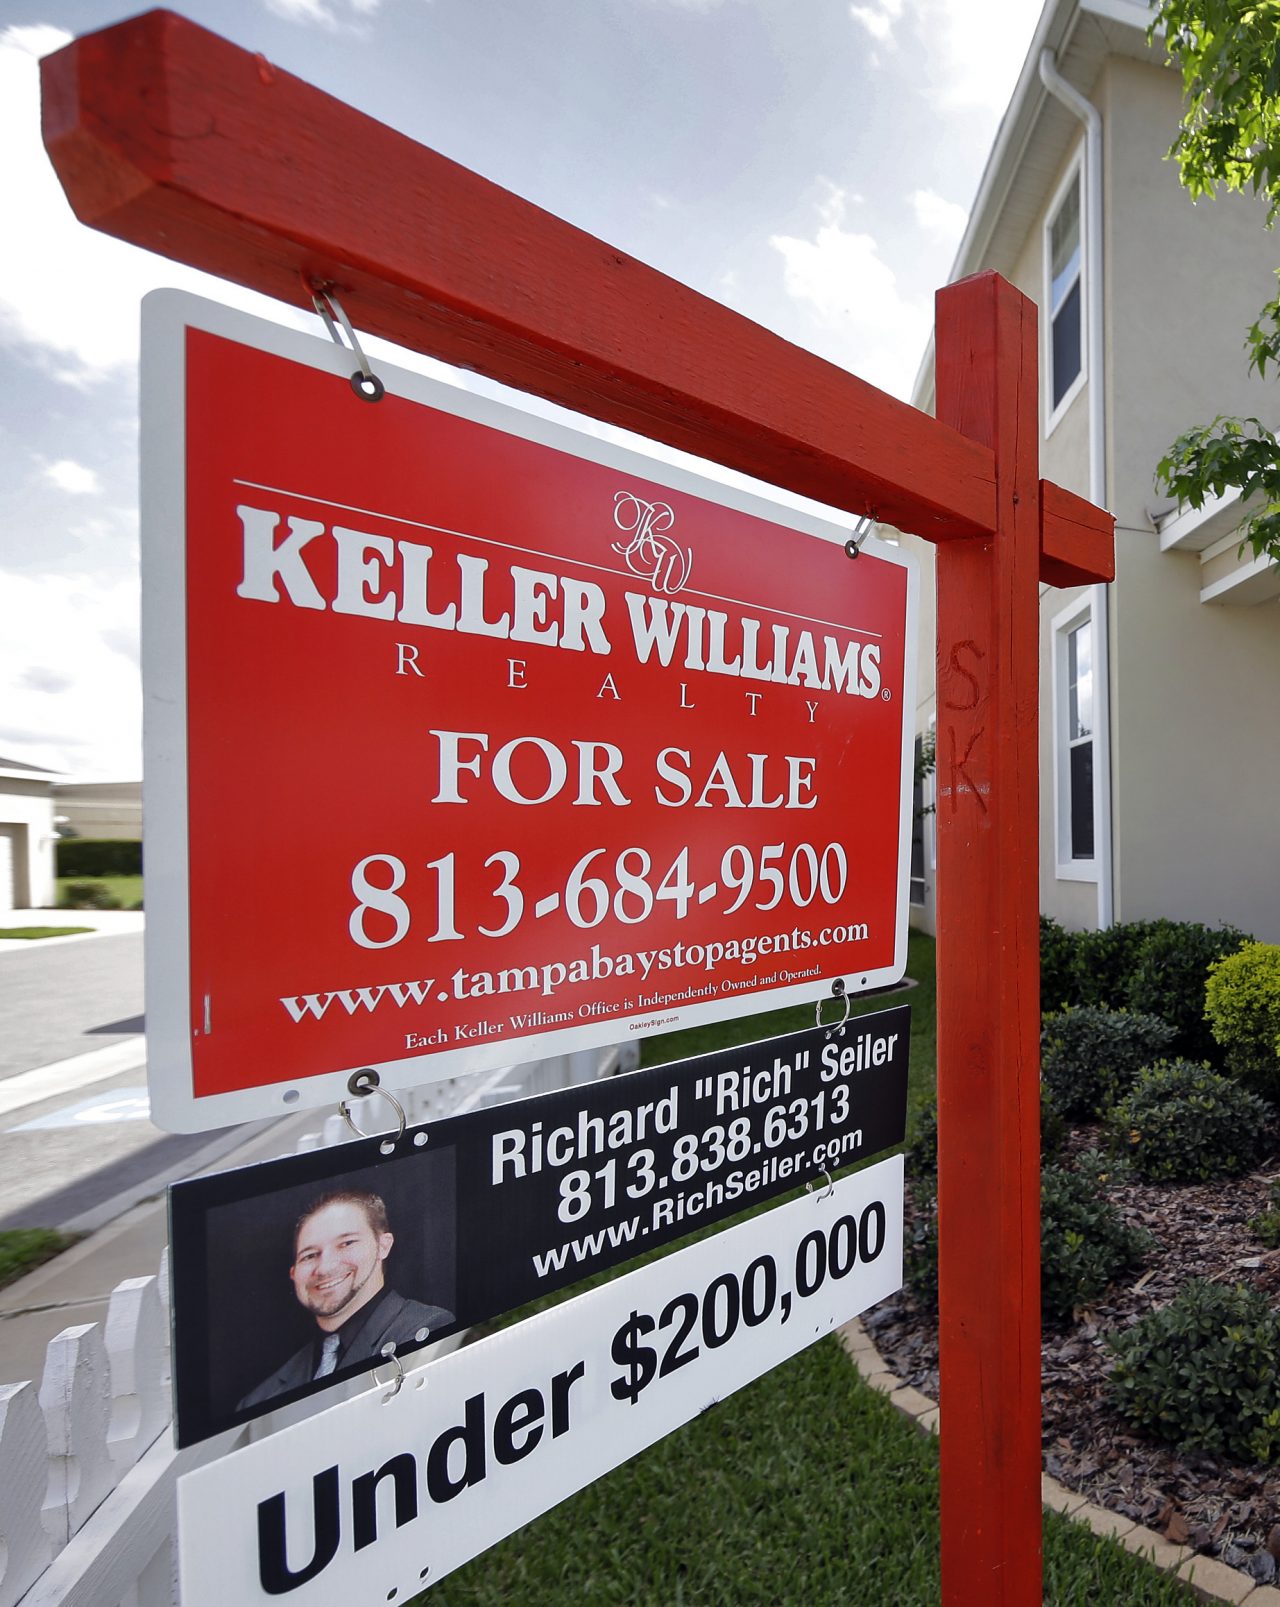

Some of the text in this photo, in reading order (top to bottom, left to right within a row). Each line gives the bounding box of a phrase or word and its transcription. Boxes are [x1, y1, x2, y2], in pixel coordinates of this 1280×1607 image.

[236, 504, 612, 656] KELLER
[395, 642, 819, 723] REALTY
[428, 729, 818, 809] FOR SALE
[348, 841, 848, 950] 813-684-9500
[279, 923, 869, 1024] www.tampabaystopagents.com
[404, 964, 822, 1050] Each Keller Williams Office is Independently Owned and Operated.
[628, 1015, 680, 1032] OakleySign.com
[491, 1032, 899, 1186] Richard "Rich" Seiler
[556, 1083, 851, 1224] 813.838.6313
[531, 1127, 864, 1279] www.RichSeiler.com
[256, 1199, 887, 1596] Under $200,000
